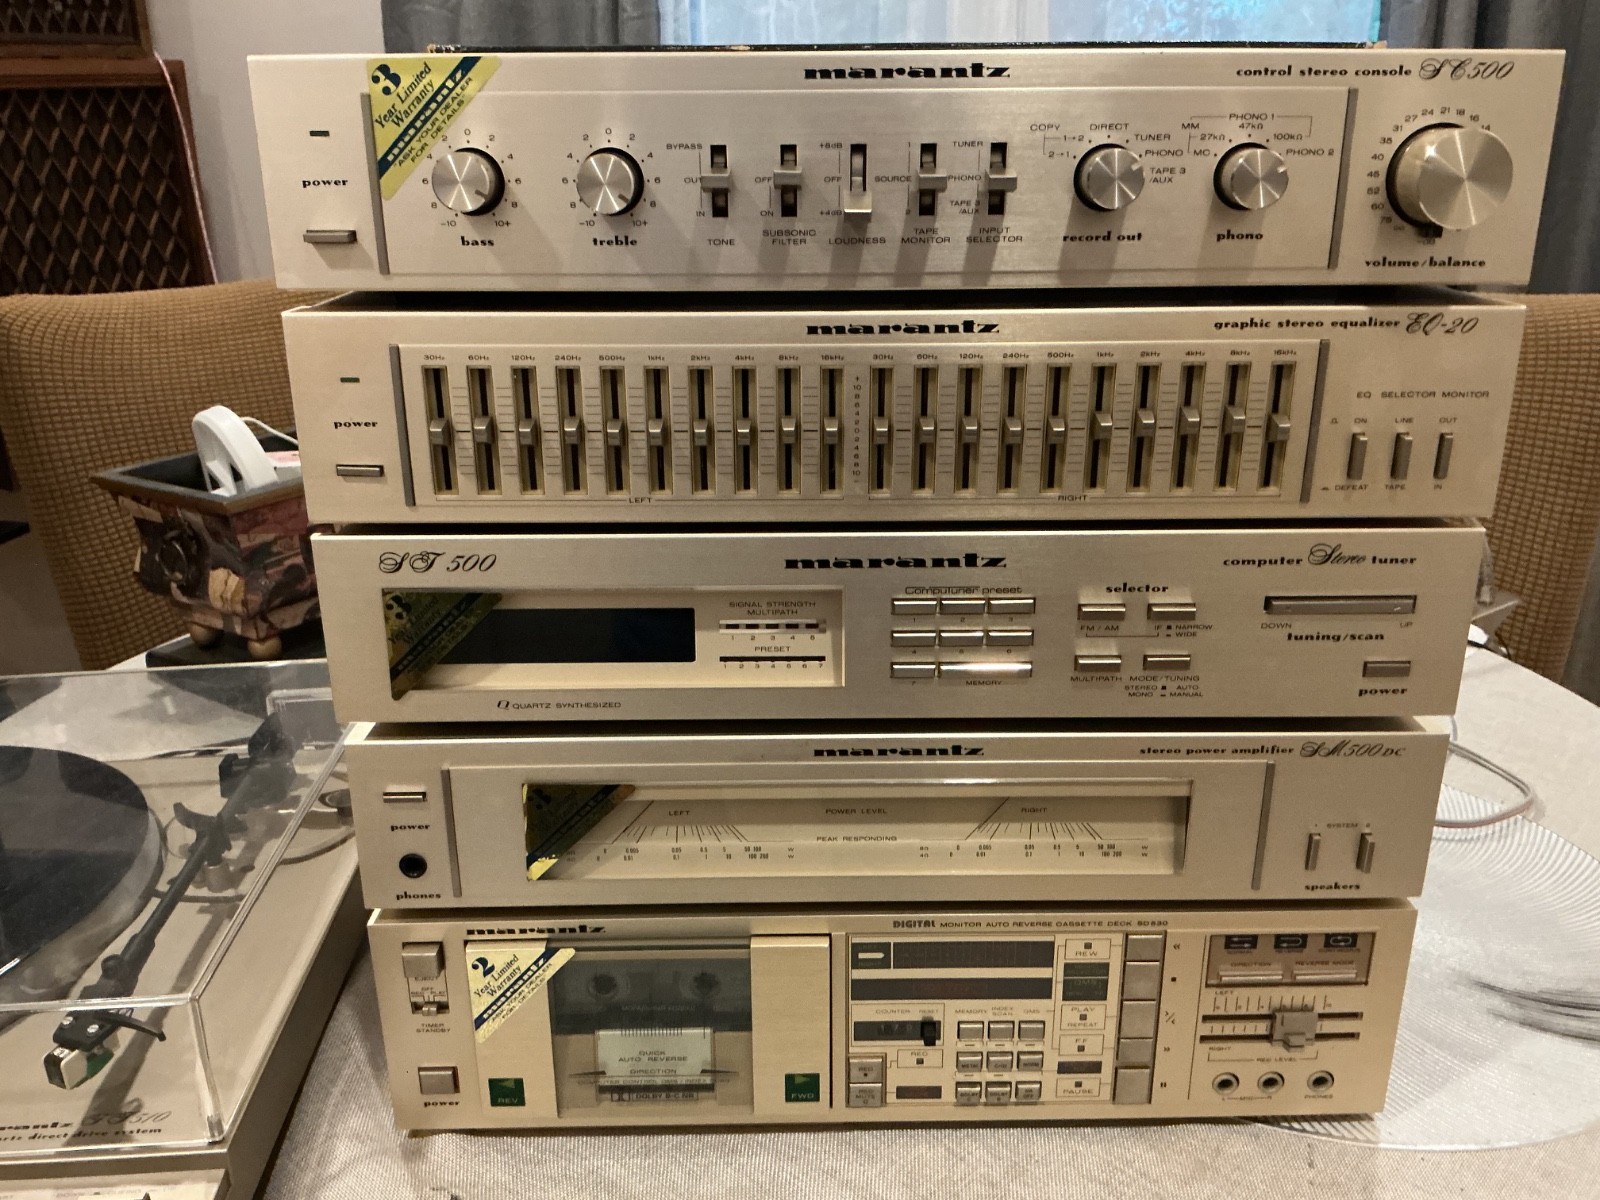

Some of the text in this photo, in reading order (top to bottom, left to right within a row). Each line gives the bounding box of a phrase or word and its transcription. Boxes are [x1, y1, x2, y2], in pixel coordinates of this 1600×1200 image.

[804, 63, 1010, 79] marantz
[1236, 66, 1292, 76] control
[1299, 66, 1348, 77] stereo
[1355, 65, 1411, 76] console
[372, 64, 401, 96] 3
[374, 62, 432, 129] Year Limited
[391, 80, 435, 128] Warranty
[416, 77, 473, 144] YOUR DEALER
[410, 142, 429, 162] FOR
[302, 178, 348, 188] power
[460, 236, 494, 246] bass
[593, 236, 638, 246] treble
[1063, 230, 1142, 242] record out
[1216, 230, 1263, 242] phono
[1365, 256, 1486, 268] volume/balance
[807, 320, 999, 335] marantz
[1214, 312, 1479, 336] graphic stereo equalizer EQ-20
[333, 421, 378, 429] power
[784, 553, 1007, 569] marantz
[1223, 543, 1417, 567] computer Stereo tuner
[1106, 582, 1168, 592] selector
[1287, 633, 1384, 642] tuning/scan
[1358, 688, 1407, 696] power
[814, 745, 984, 756] marantz
[1140, 746, 1181, 754] stereo
[1232, 745, 1294, 755] amplifier
[1305, 882, 1360, 891] speakers
[396, 892, 441, 900] phones
[467, 925, 606, 935] marantz
[472, 957, 495, 977] 2
[474, 954, 519, 998] Year Limited
[487, 965, 521, 997] Warranty
